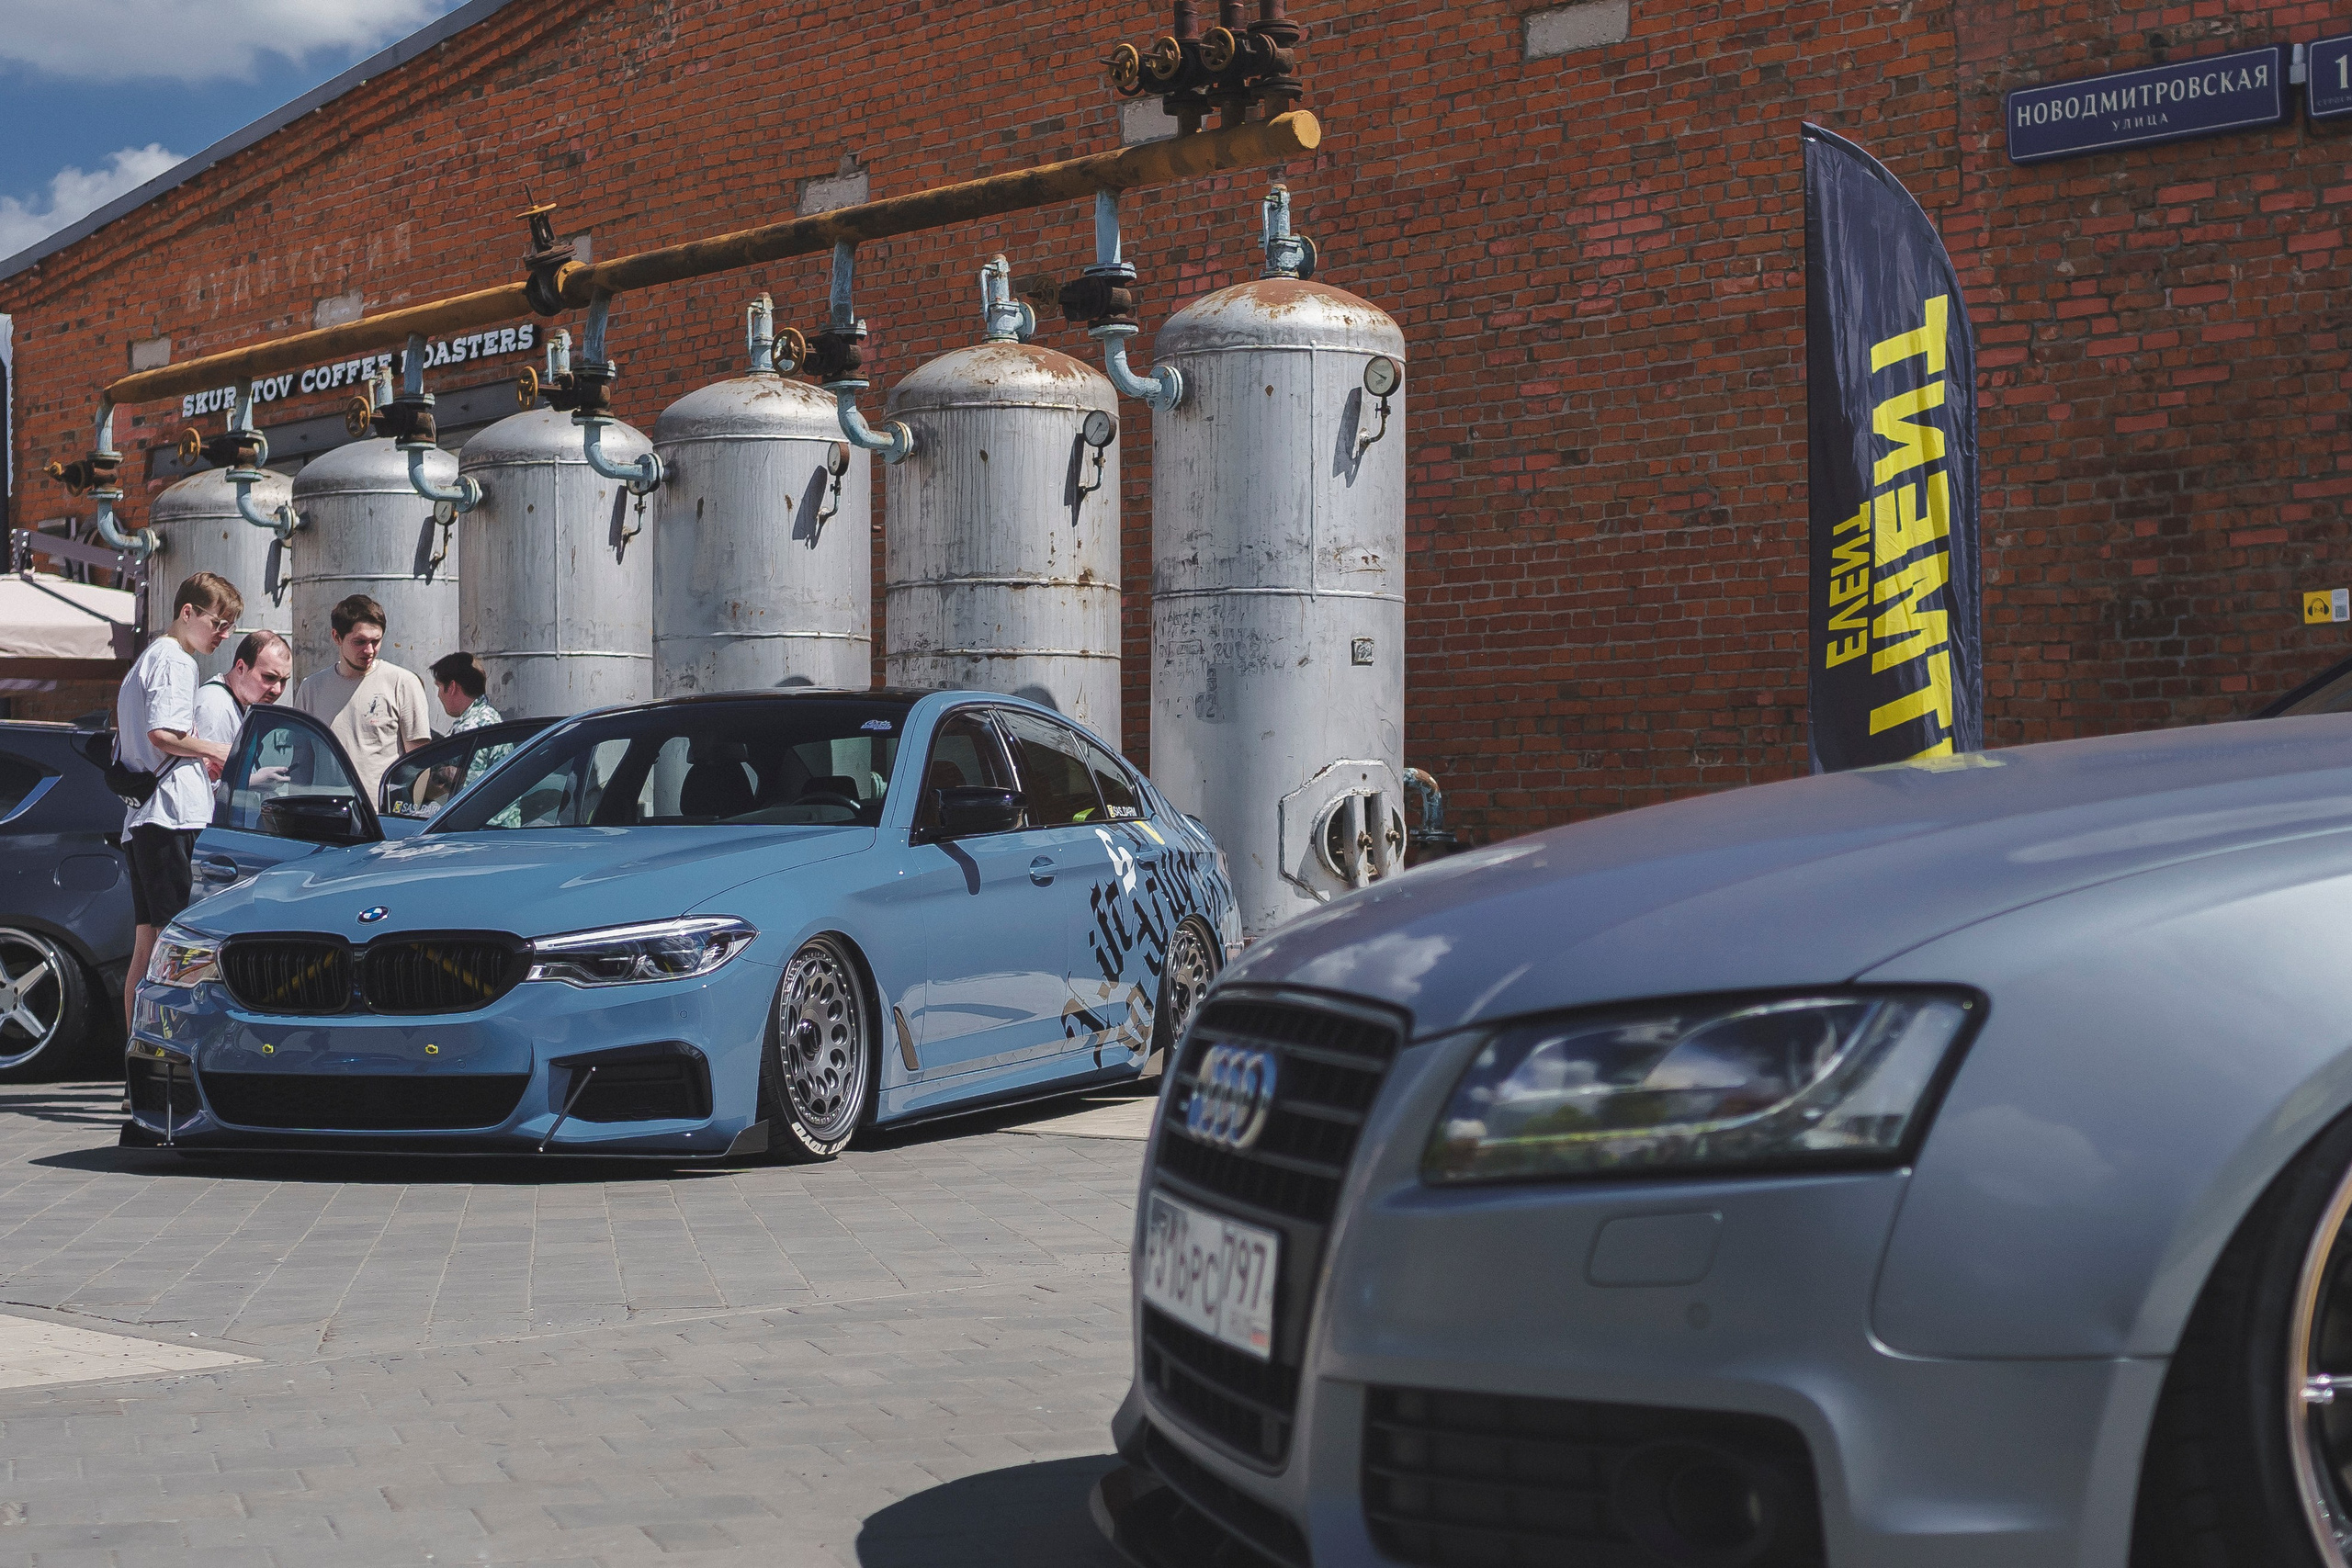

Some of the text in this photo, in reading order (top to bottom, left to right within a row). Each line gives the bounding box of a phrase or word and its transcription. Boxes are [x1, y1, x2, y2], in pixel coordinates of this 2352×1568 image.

[2018, 64, 2268, 127] НОВОДМИТРОВСКАЯ
[2112, 112, 2169, 132] УЛИЦА
[182, 374, 293, 418] SKURTOV
[401, 323, 534, 374] OASTERS
[791, 1122, 828, 1155] TOYO
